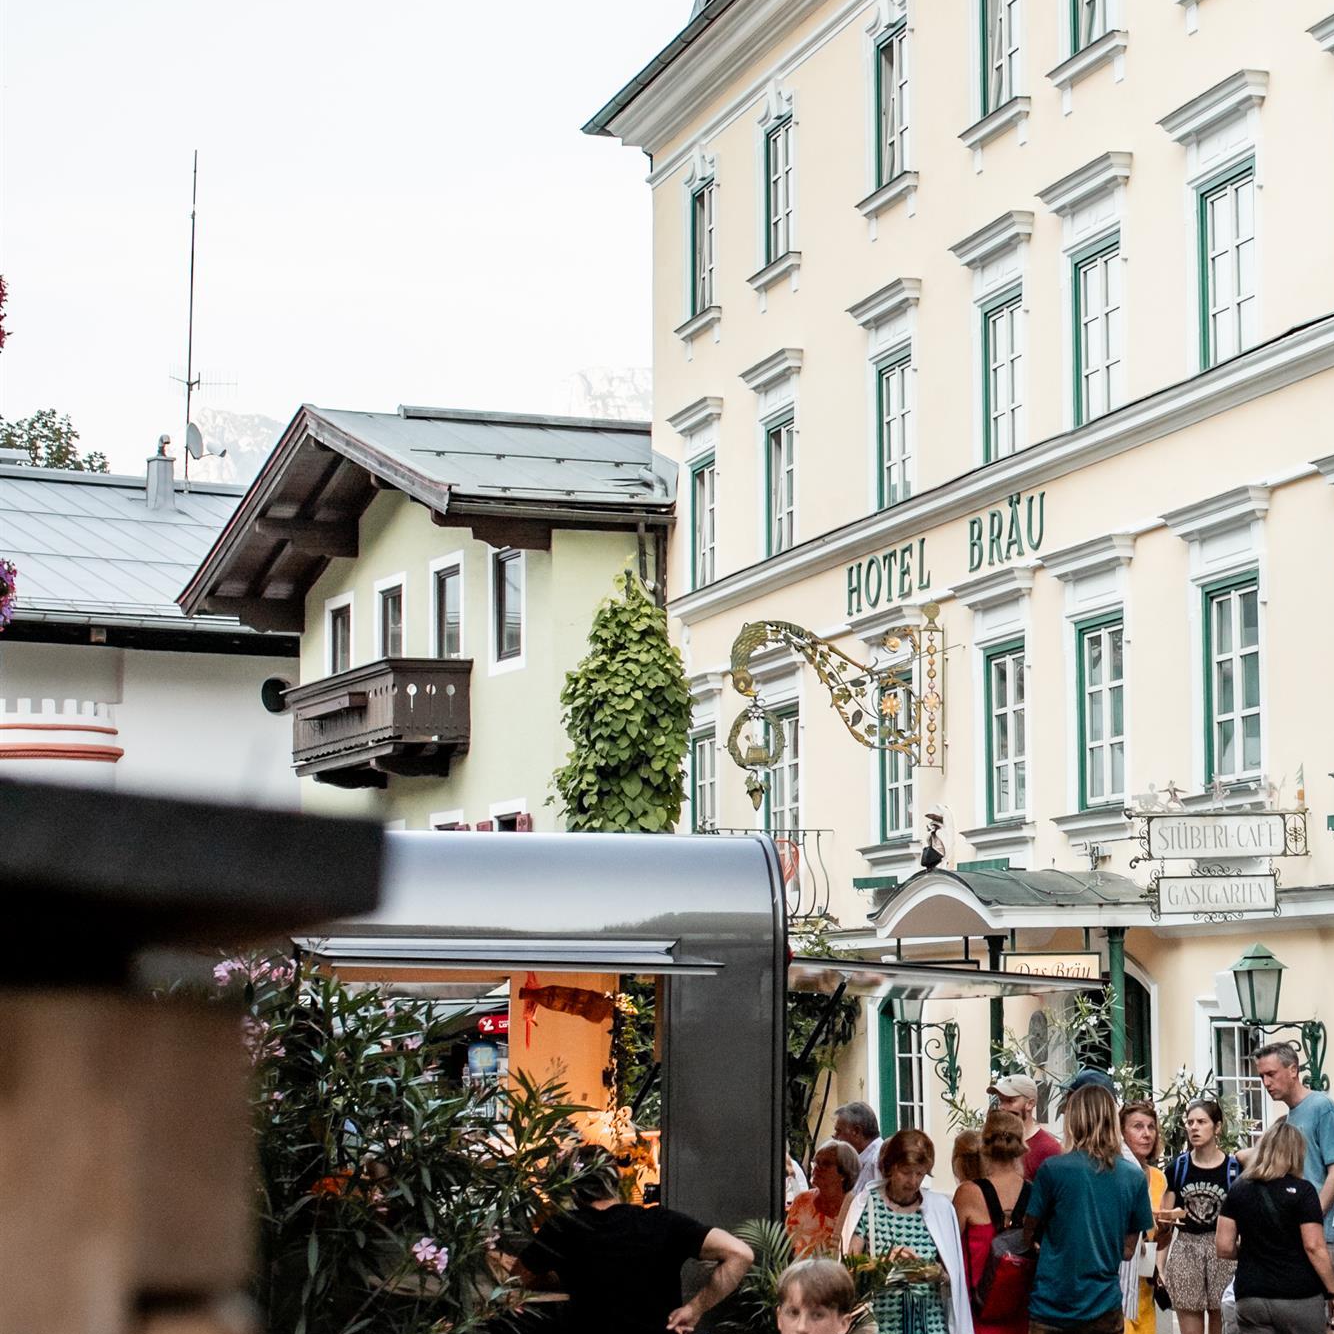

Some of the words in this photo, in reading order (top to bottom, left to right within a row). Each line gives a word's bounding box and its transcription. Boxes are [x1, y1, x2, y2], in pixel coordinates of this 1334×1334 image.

[846, 537, 931, 617] HOTEL
[968, 491, 1046, 573] BRÄU
[1167, 882, 1269, 906] GASTGARTEN
